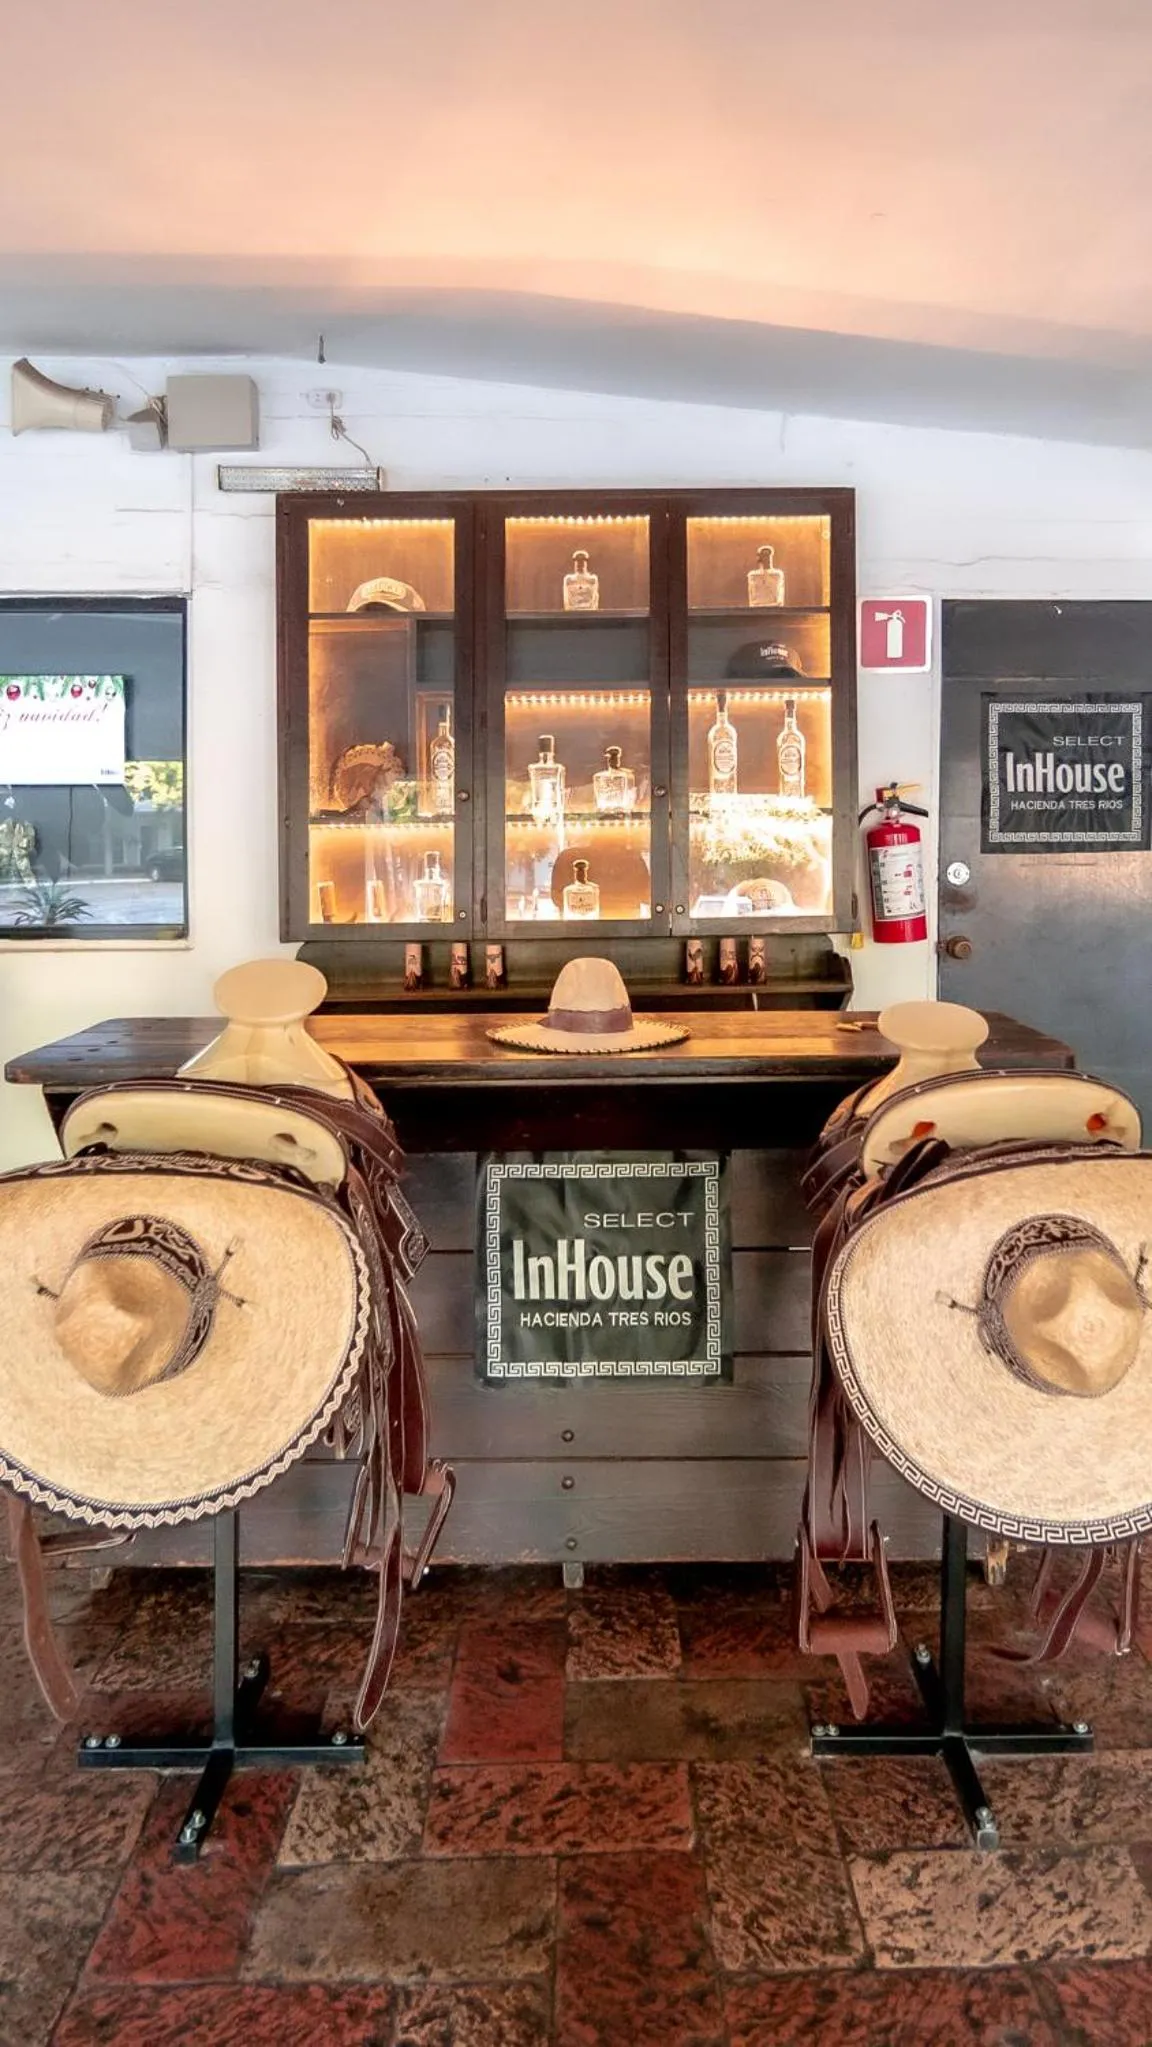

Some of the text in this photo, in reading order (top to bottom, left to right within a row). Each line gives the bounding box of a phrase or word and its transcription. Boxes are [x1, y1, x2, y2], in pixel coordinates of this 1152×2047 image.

[1052, 735, 1126, 746] SELECT
[1006, 752, 1125, 793] InHouse
[1010, 800, 1124, 810] HACIENDA TRES RIOS
[583, 1212, 695, 1228] SELECT
[513, 1239, 694, 1301] InHouse
[520, 1311, 692, 1328] HACIENDA TRES RIOS
